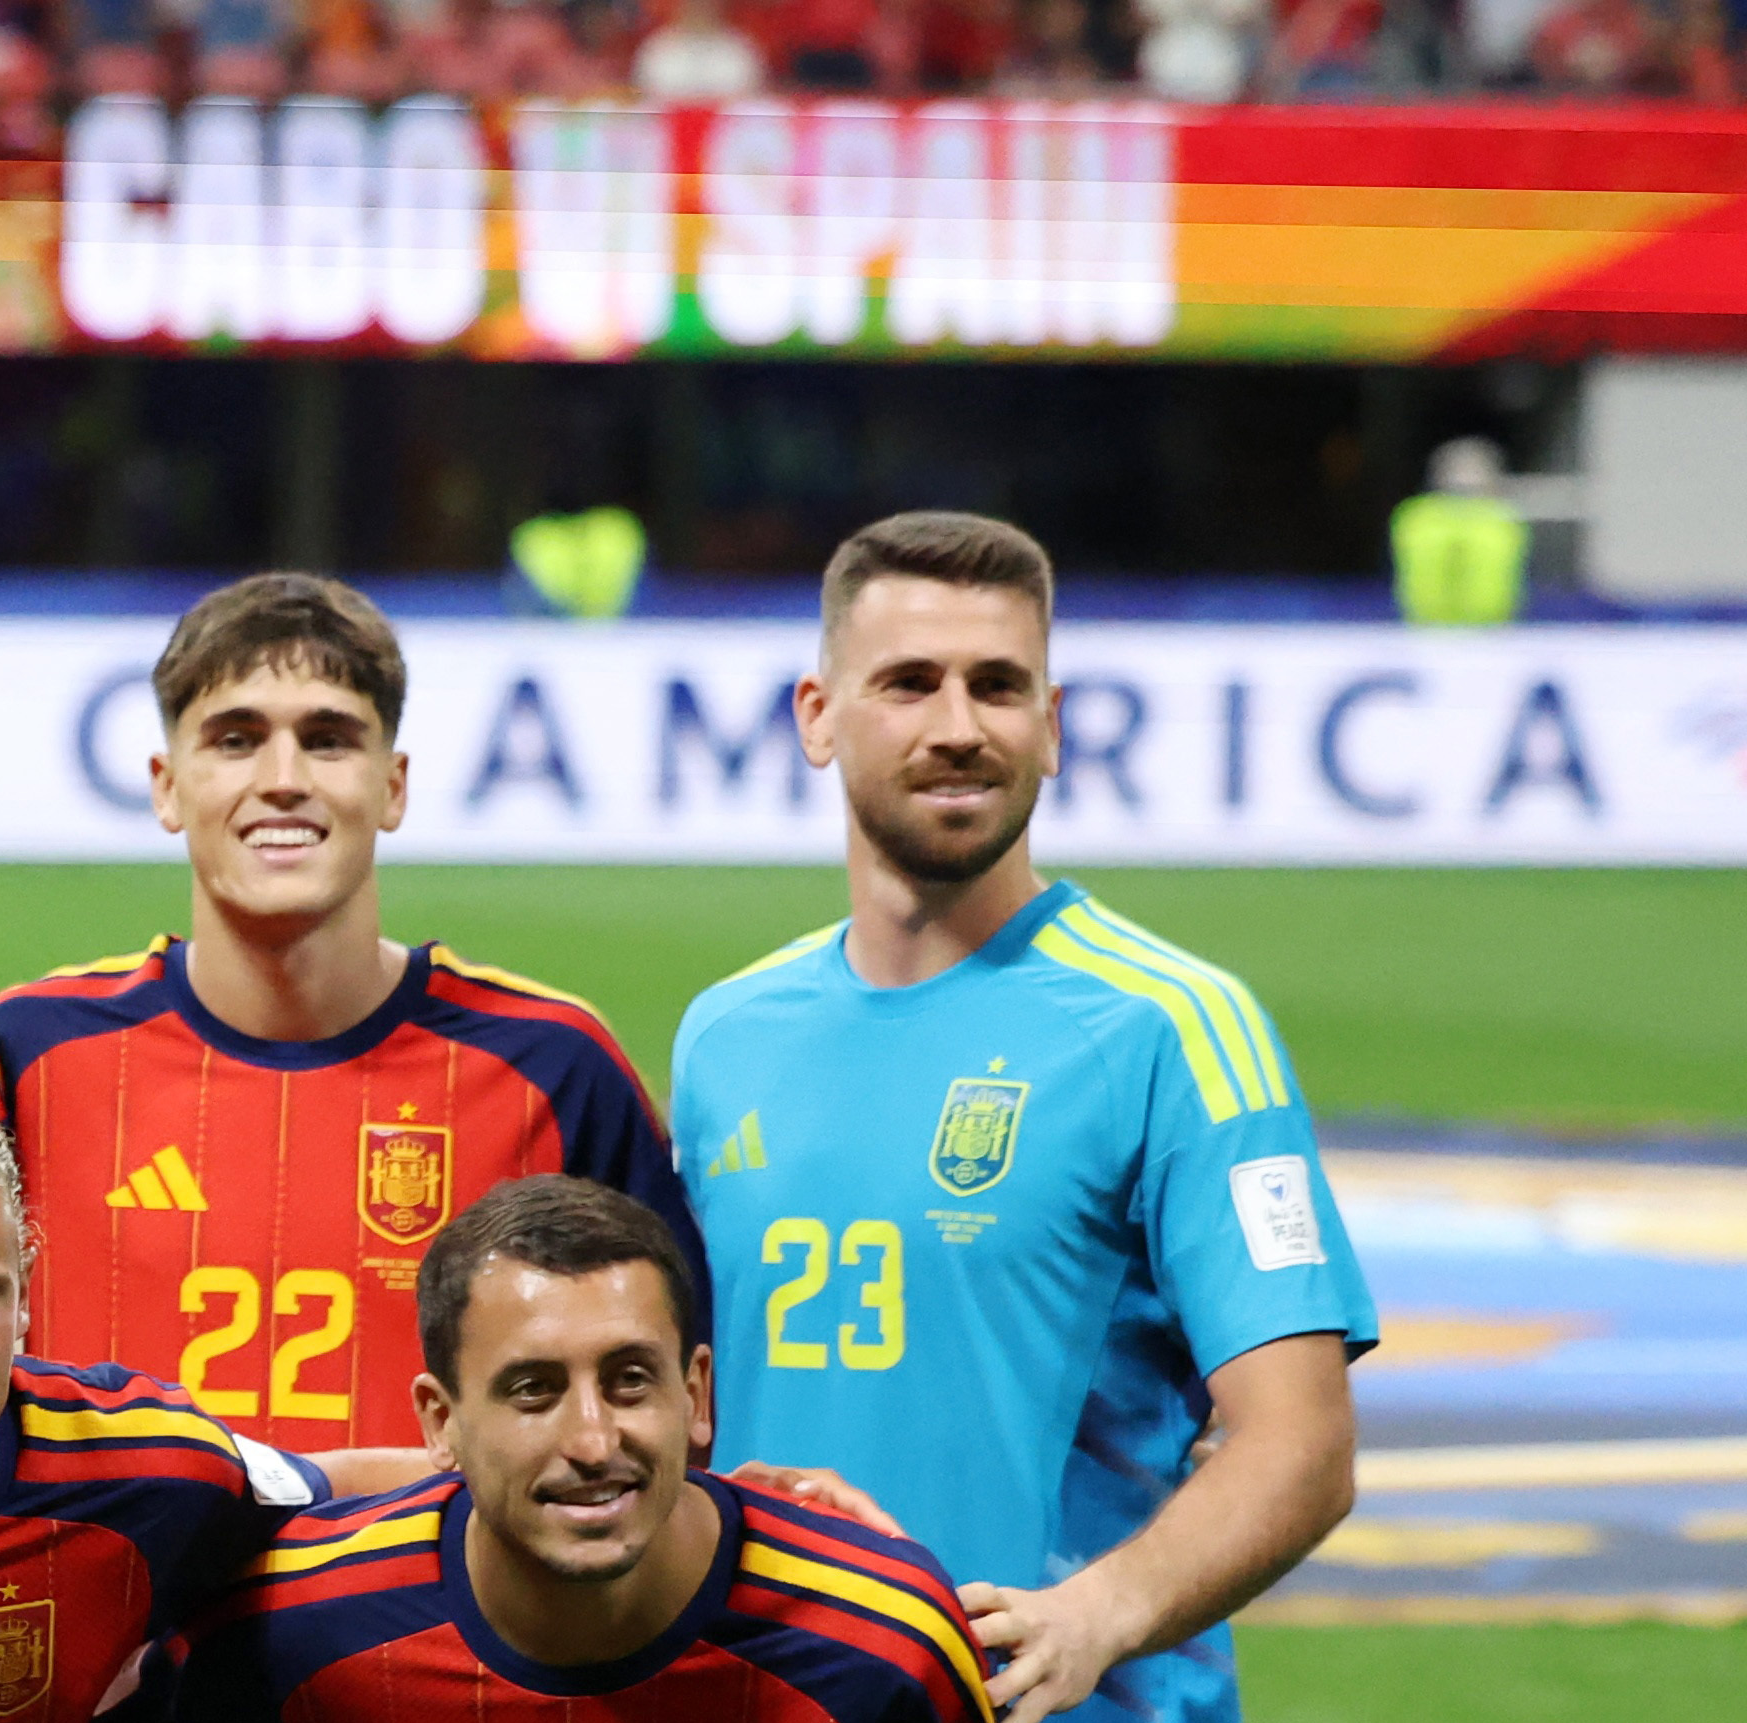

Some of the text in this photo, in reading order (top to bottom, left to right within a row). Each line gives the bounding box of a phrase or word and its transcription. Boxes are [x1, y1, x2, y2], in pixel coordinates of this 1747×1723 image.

[705, 98, 1175, 346] SPAIN
[464, 674, 1604, 818] AMRICA
[179, 1266, 355, 1420] 22
[761, 1218, 905, 1370] 23
